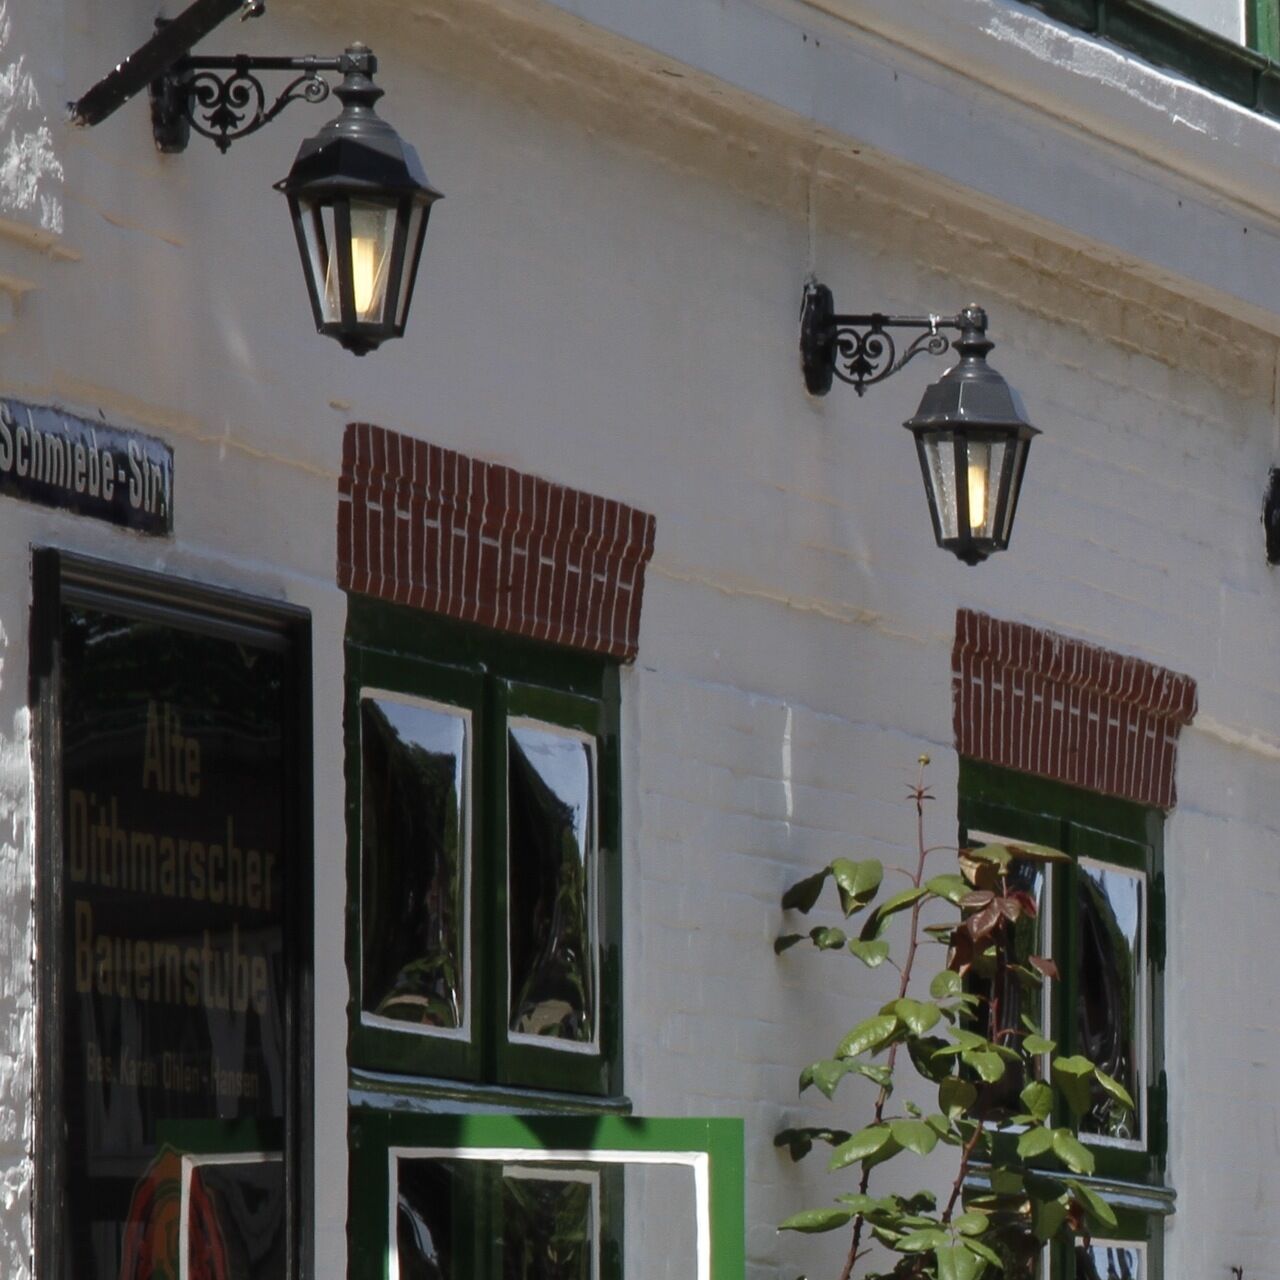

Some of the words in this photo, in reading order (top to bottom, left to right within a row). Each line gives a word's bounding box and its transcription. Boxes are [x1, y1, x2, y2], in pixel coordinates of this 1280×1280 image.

[143, 699, 202, 797] Alte
[70, 790, 275, 909] Dithmarscher
[74, 903, 267, 1014] Bauernstube
